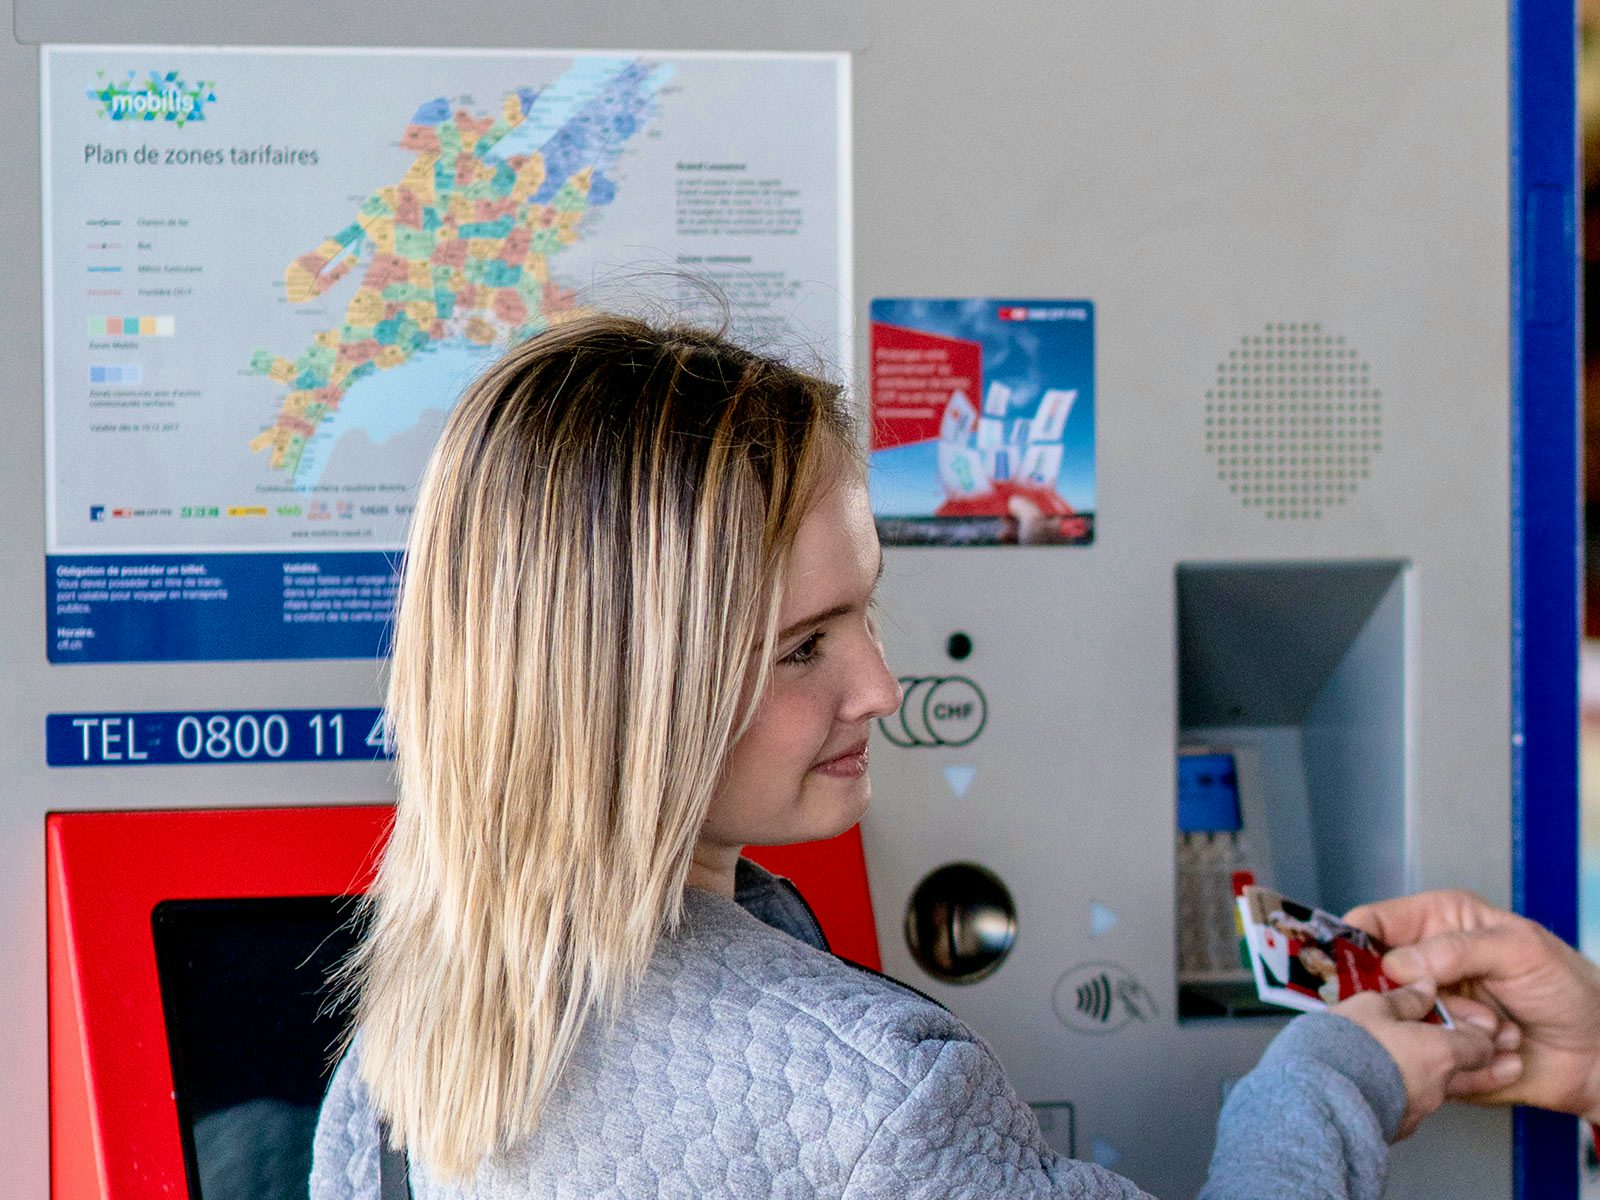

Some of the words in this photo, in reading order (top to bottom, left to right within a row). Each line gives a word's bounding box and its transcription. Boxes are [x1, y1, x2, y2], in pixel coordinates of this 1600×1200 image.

[111, 85, 195, 113] mobilis
[84, 143, 127, 164] Plan
[133, 143, 159, 164] de
[164, 149, 224, 165] zones
[230, 143, 319, 165] tarifaires
[107, 565, 119, 576] de
[934, 703, 973, 720] CHF
[177, 715, 288, 759] 0800
[309, 714, 343, 756] 11
